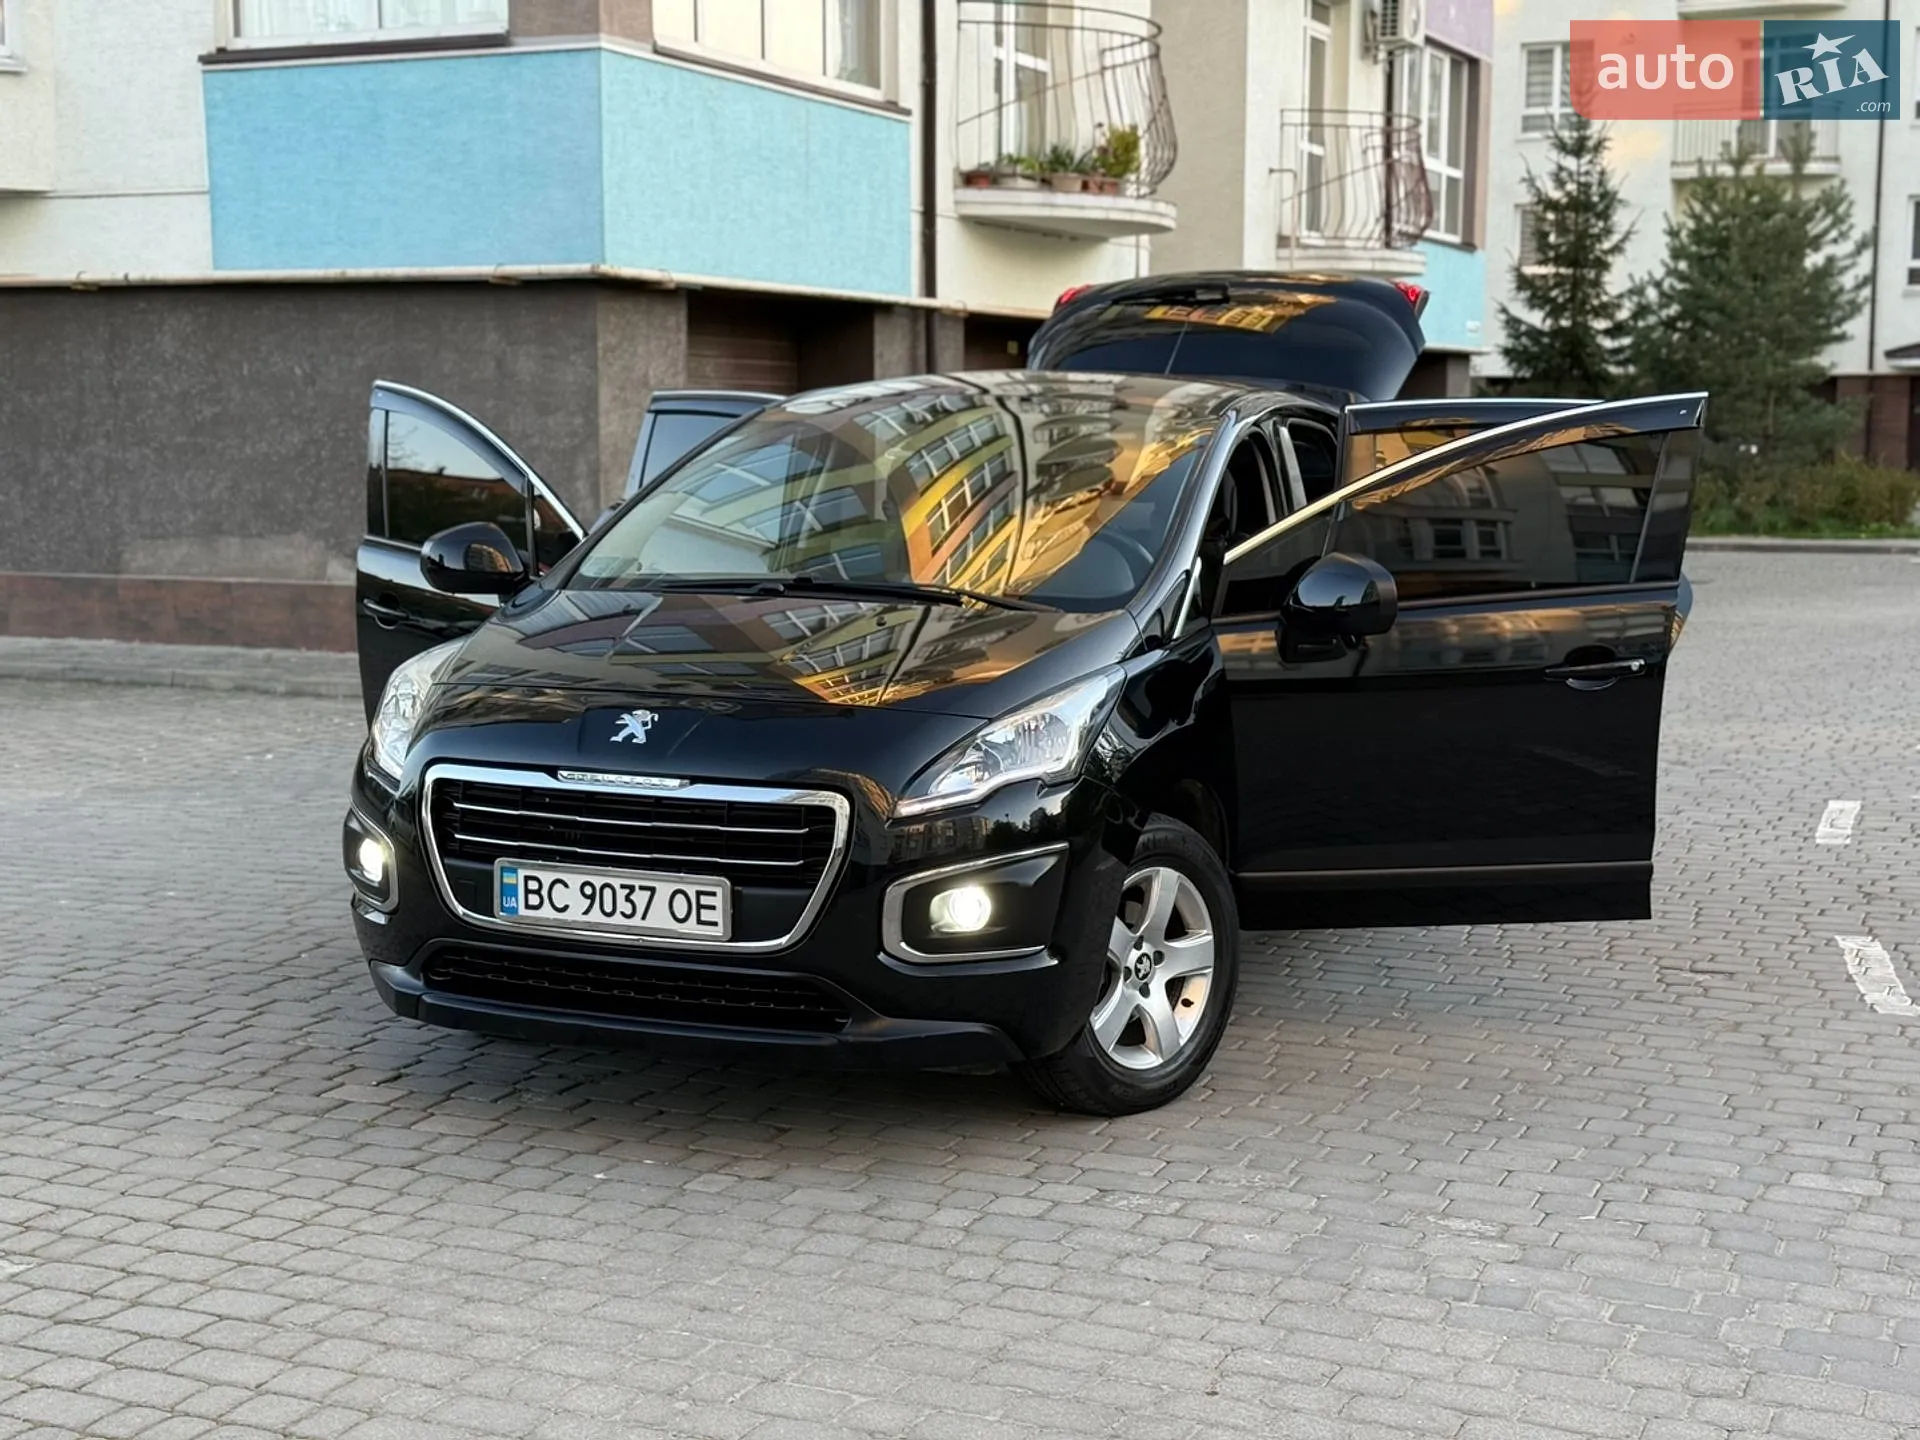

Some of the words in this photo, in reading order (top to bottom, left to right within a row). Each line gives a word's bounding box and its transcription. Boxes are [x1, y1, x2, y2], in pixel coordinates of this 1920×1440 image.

[503, 896, 518, 909] UA
[523, 875, 571, 914] BC
[579, 880, 657, 921] 9037
[668, 888, 719, 927] OE
